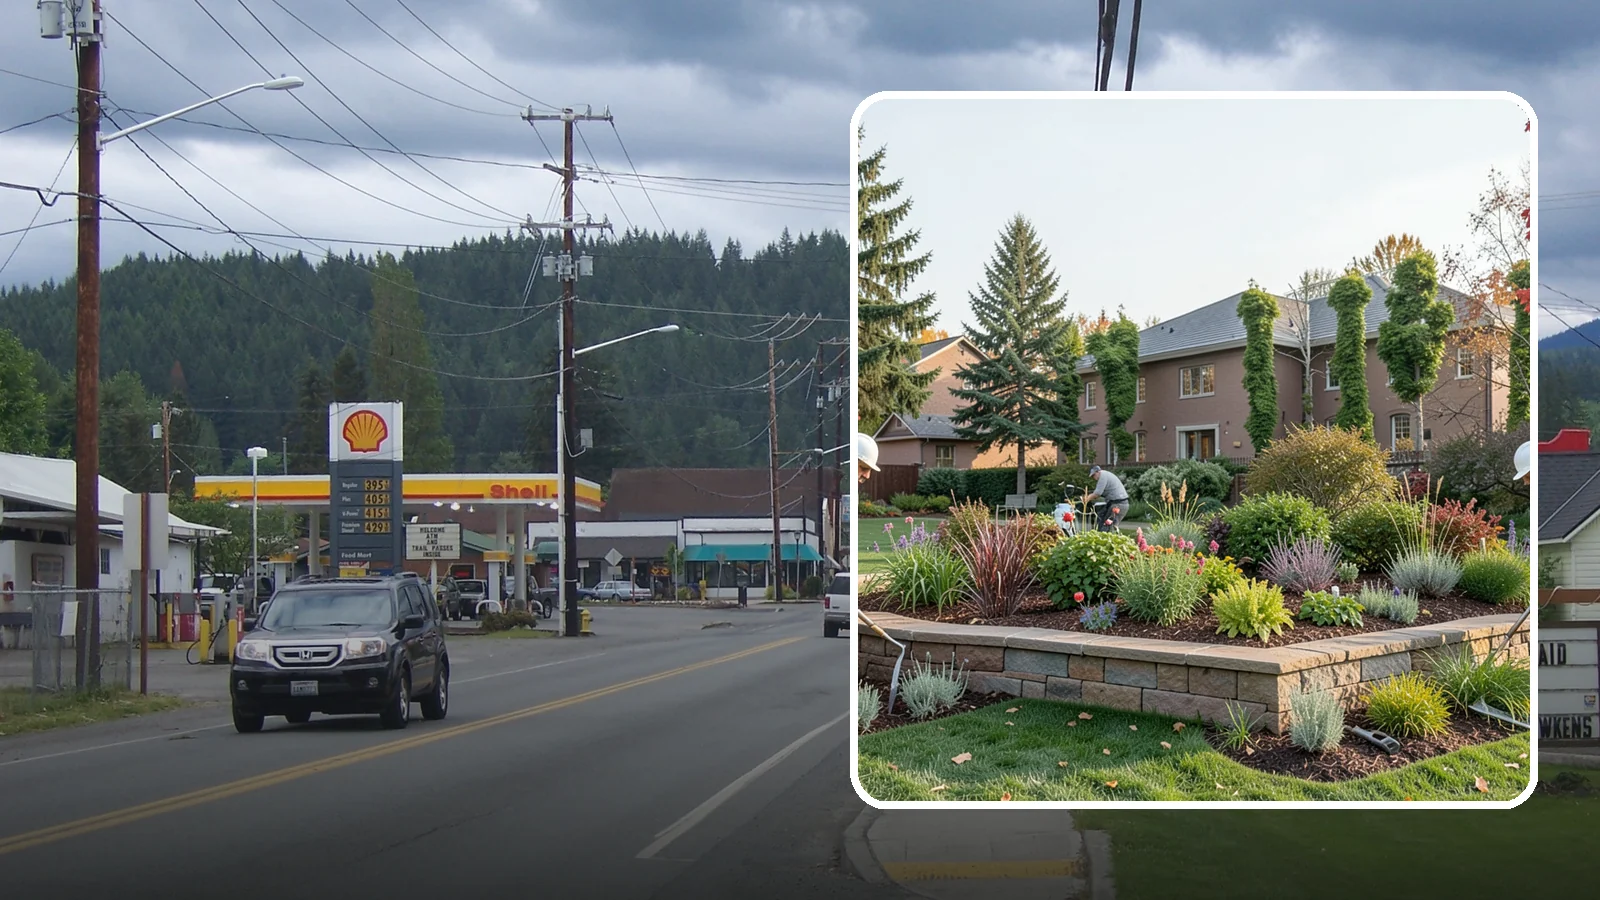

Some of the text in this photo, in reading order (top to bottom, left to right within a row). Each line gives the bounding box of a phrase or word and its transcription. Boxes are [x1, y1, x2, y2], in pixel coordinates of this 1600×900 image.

[366, 480, 383, 490] 395
[490, 484, 547, 499] Shell
[365, 494, 383, 504] 405
[365, 508, 383, 518] 415
[365, 522, 383, 532] 429
